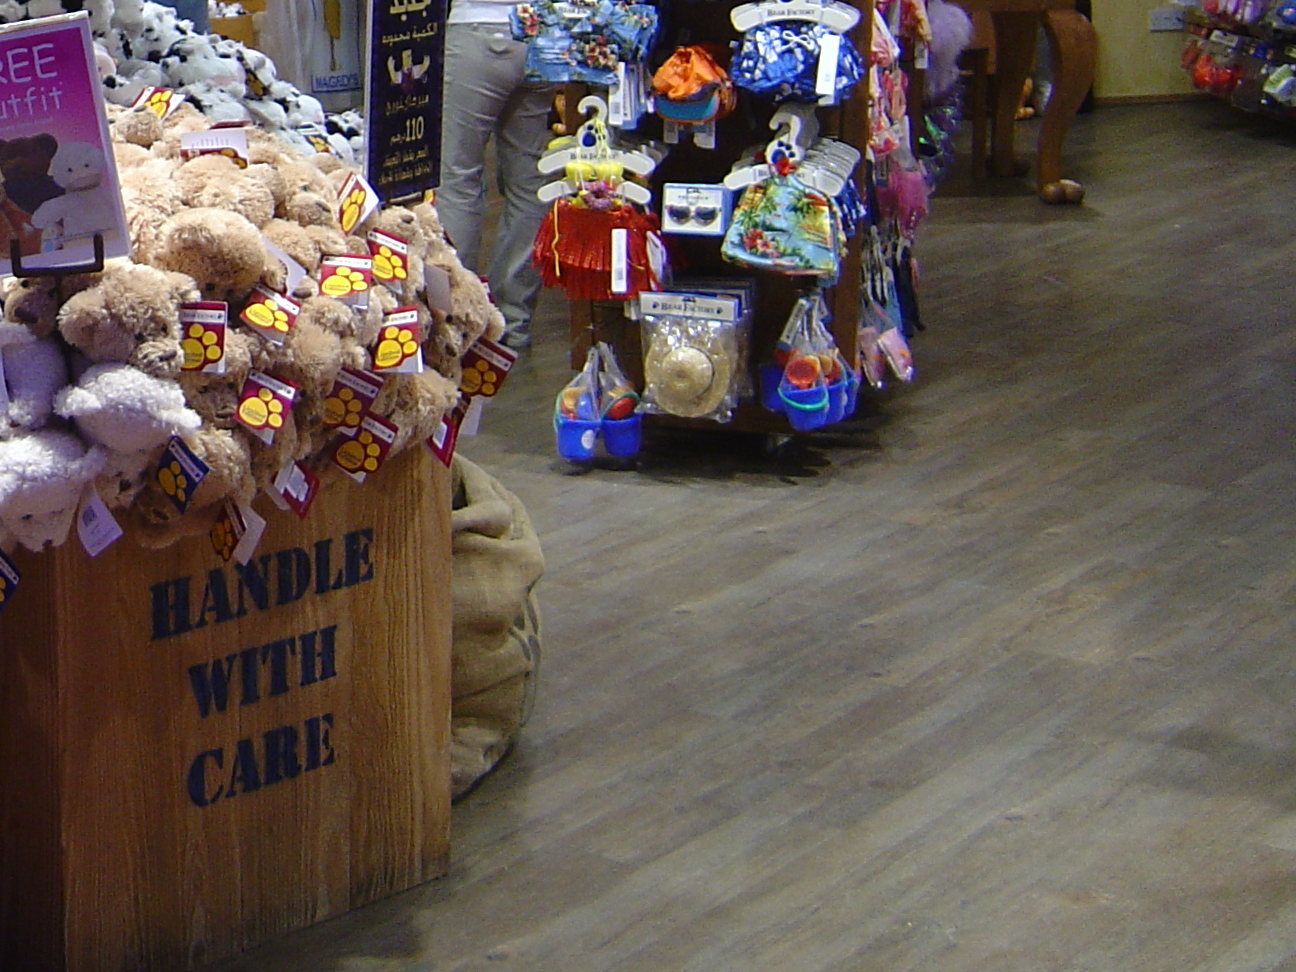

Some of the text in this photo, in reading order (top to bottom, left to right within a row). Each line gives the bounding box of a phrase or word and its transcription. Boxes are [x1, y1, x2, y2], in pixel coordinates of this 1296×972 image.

[406, 115, 424, 142] 110
[150, 528, 374, 641] HANDLE
[188, 624, 337, 719] WITH
[188, 712, 336, 807] CARE
